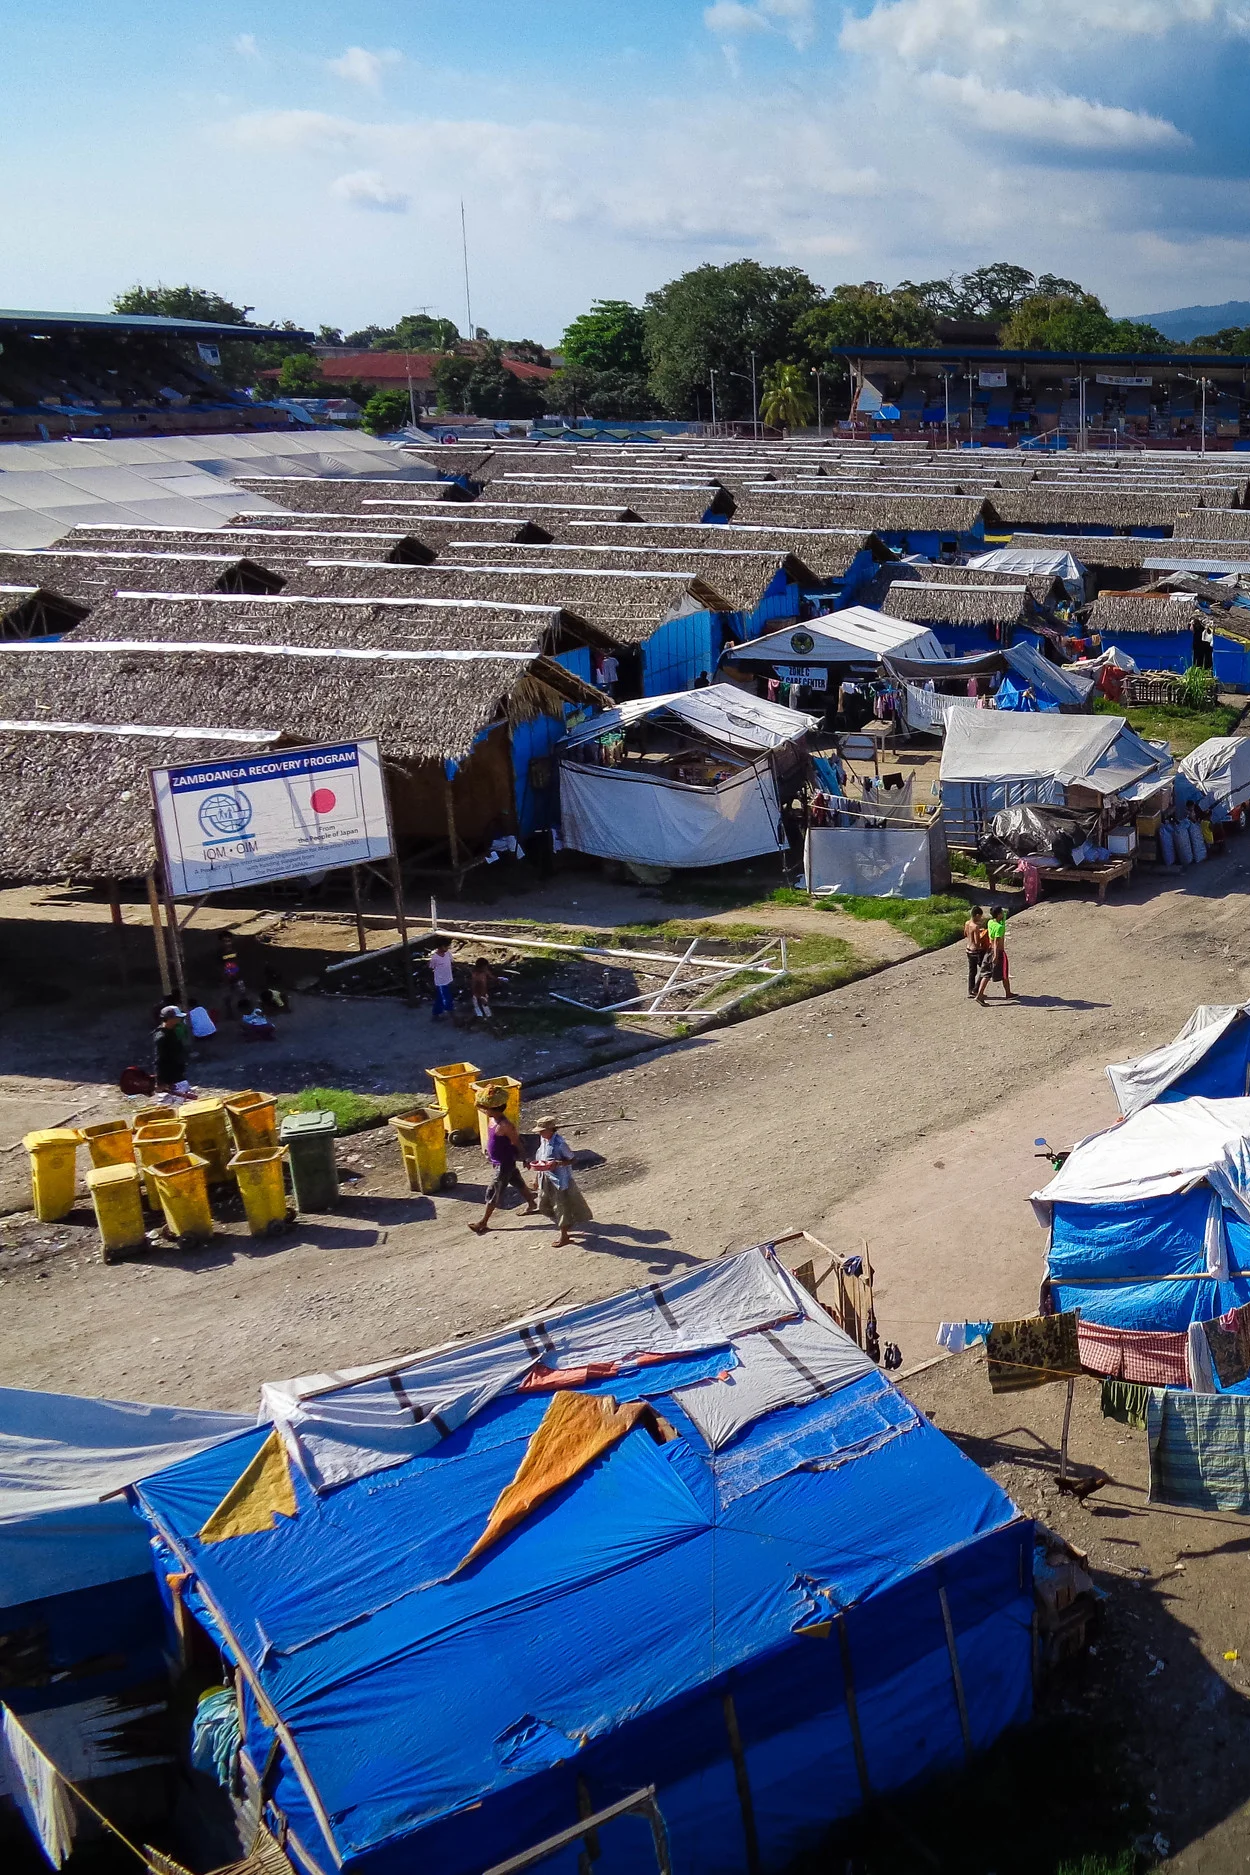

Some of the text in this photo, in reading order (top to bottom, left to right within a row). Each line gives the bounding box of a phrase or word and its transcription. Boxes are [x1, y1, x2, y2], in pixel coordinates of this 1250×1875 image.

[172, 751, 356, 787] ZAMBOANGA RECOVERY PROGRAM
[310, 832, 332, 842] People
[340, 828, 359, 837] Japan
[203, 840, 259, 861] IOM OIM
